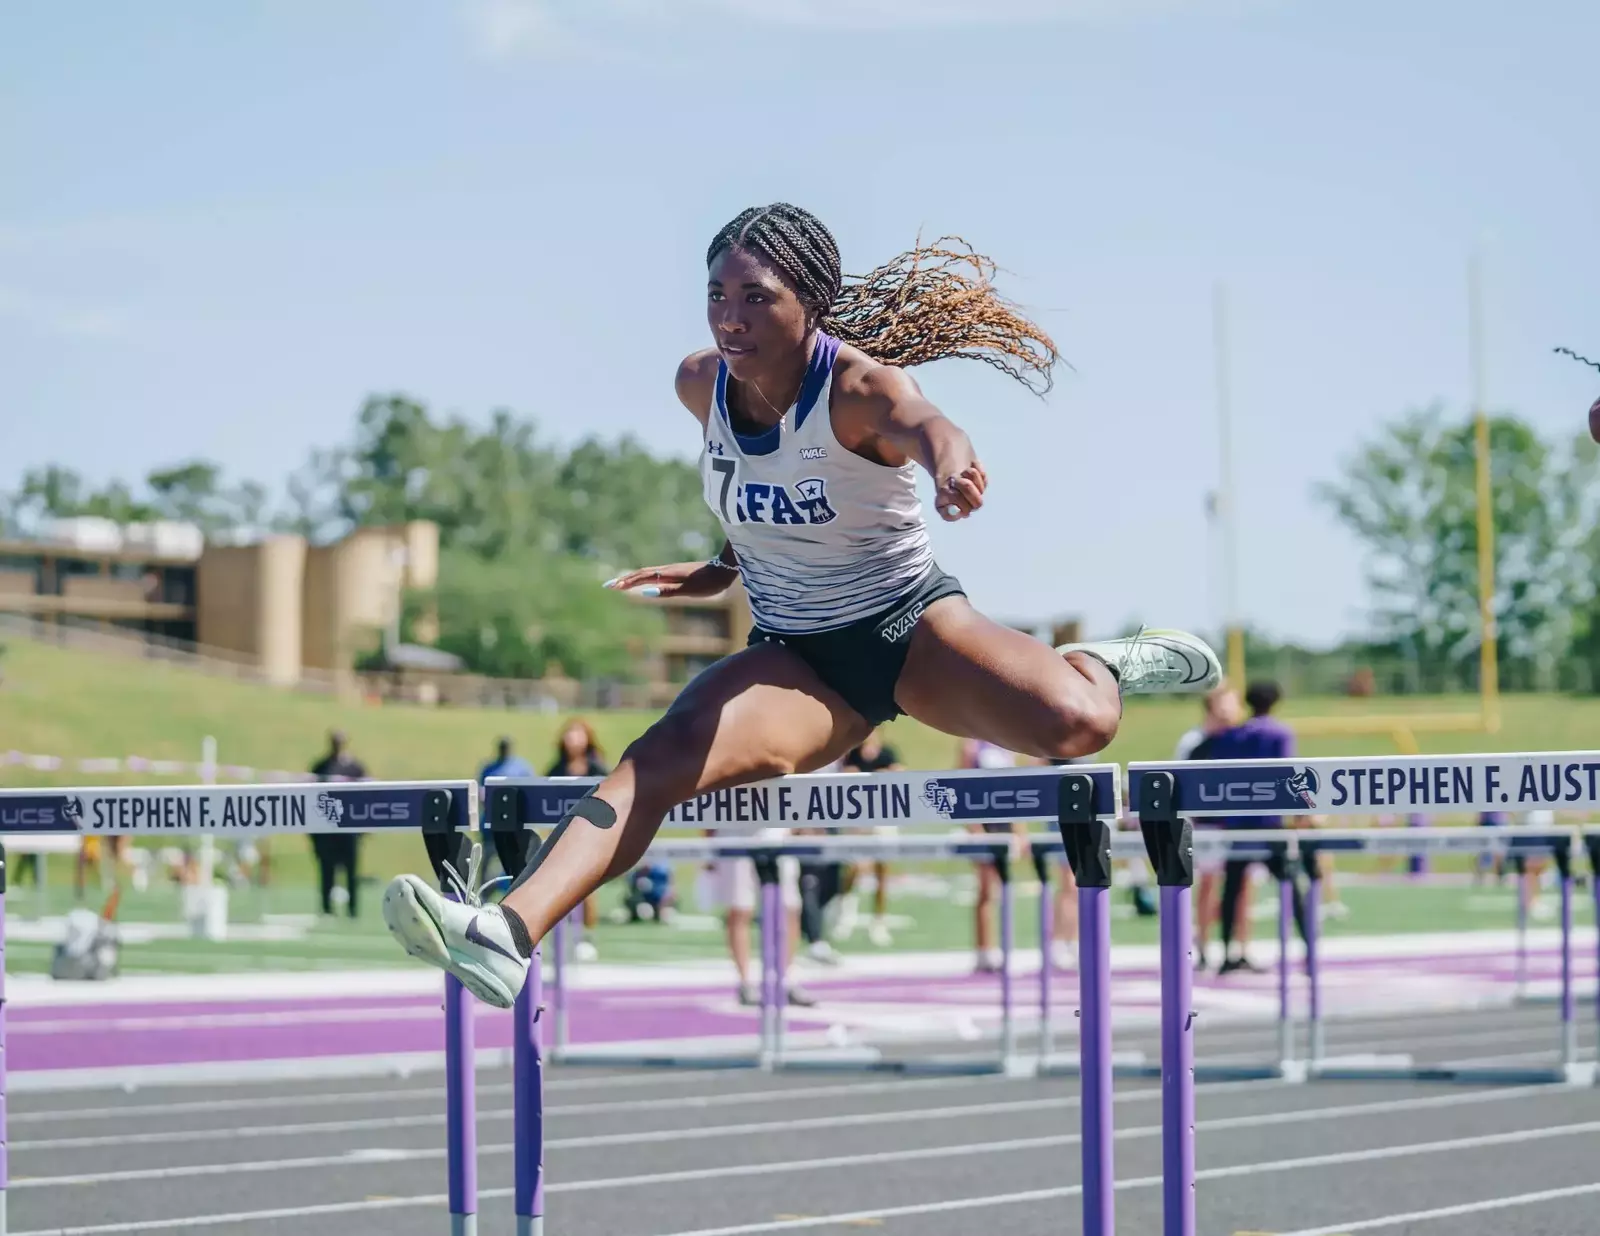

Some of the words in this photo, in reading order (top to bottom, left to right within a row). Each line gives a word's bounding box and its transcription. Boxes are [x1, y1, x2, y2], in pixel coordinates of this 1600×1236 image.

[800, 447, 828, 460] WAC
[711, 457, 736, 524] 7
[882, 601, 925, 643] WAC
[669, 787, 770, 822] EPHEN
[778, 787, 799, 821] F.
[807, 783, 911, 821] AUSTIN
[924, 780, 954, 813] SFA
[964, 789, 1041, 811] UCS
[1199, 781, 1277, 802] UCS
[1331, 766, 1474, 806] STEPHEN
[1485, 766, 1509, 803] F.
[2, 808, 56, 824] UCS
[93, 797, 191, 829] STEPHEN
[200, 797, 216, 827] F.
[222, 795, 306, 827] AUSTIN
[349, 802, 410, 820] UCS
